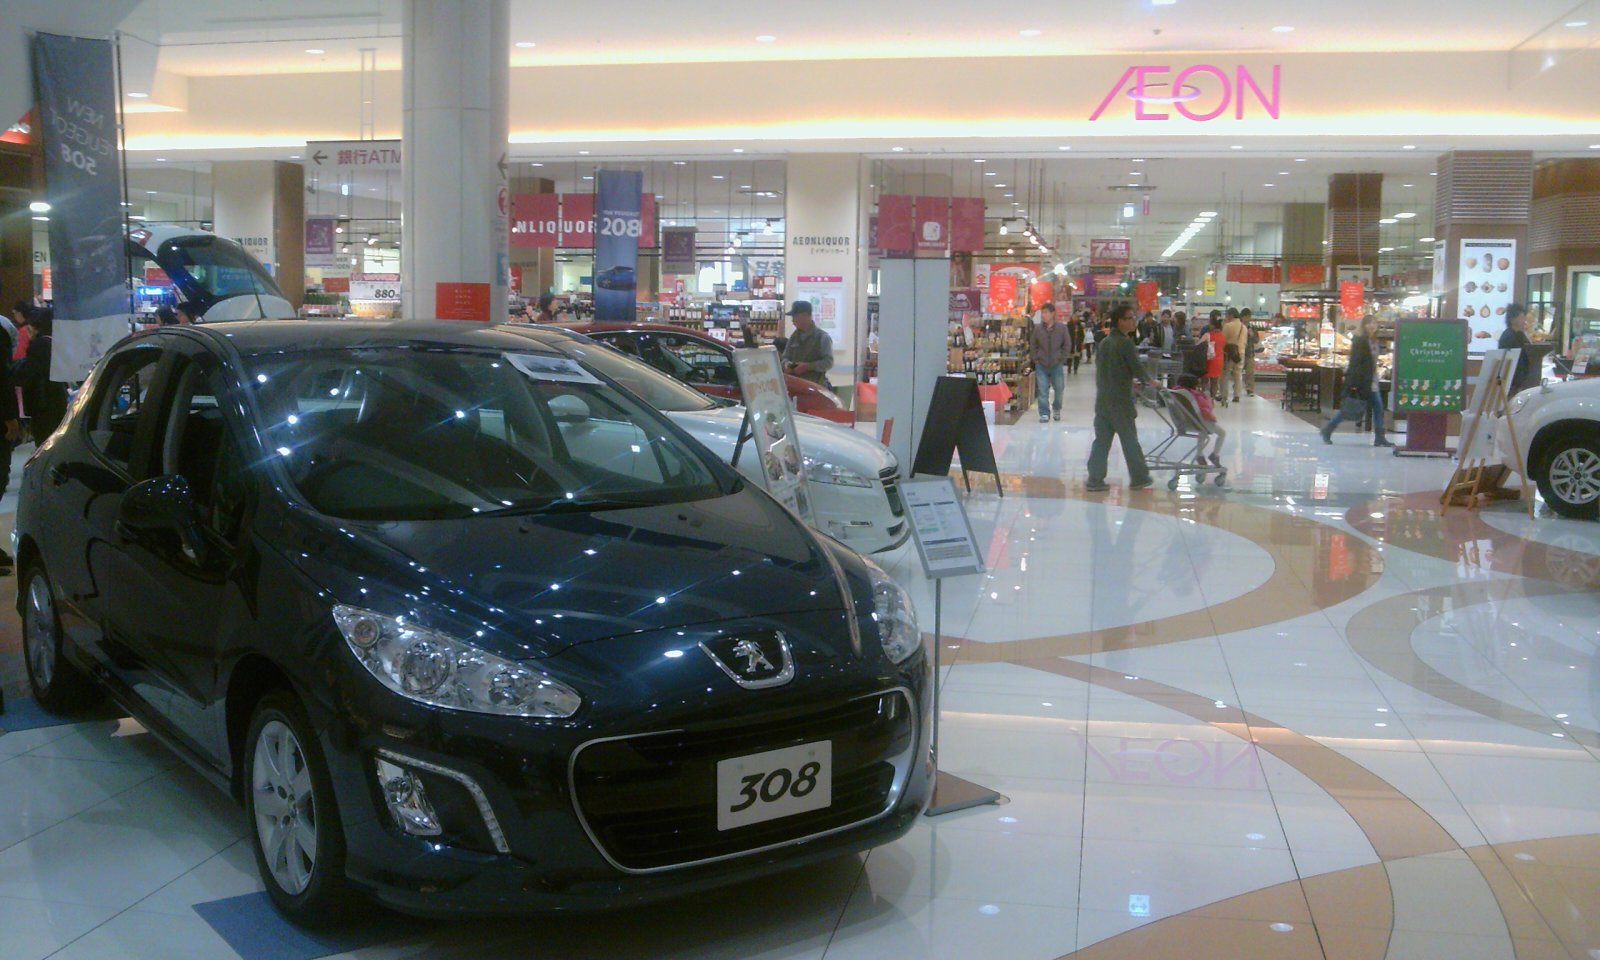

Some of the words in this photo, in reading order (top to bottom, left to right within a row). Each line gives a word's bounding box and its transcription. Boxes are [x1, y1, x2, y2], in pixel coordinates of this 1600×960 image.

[601, 218, 641, 237] 208
[792, 236, 850, 248] AEONLIQUOR
[730, 761, 821, 813] 308
